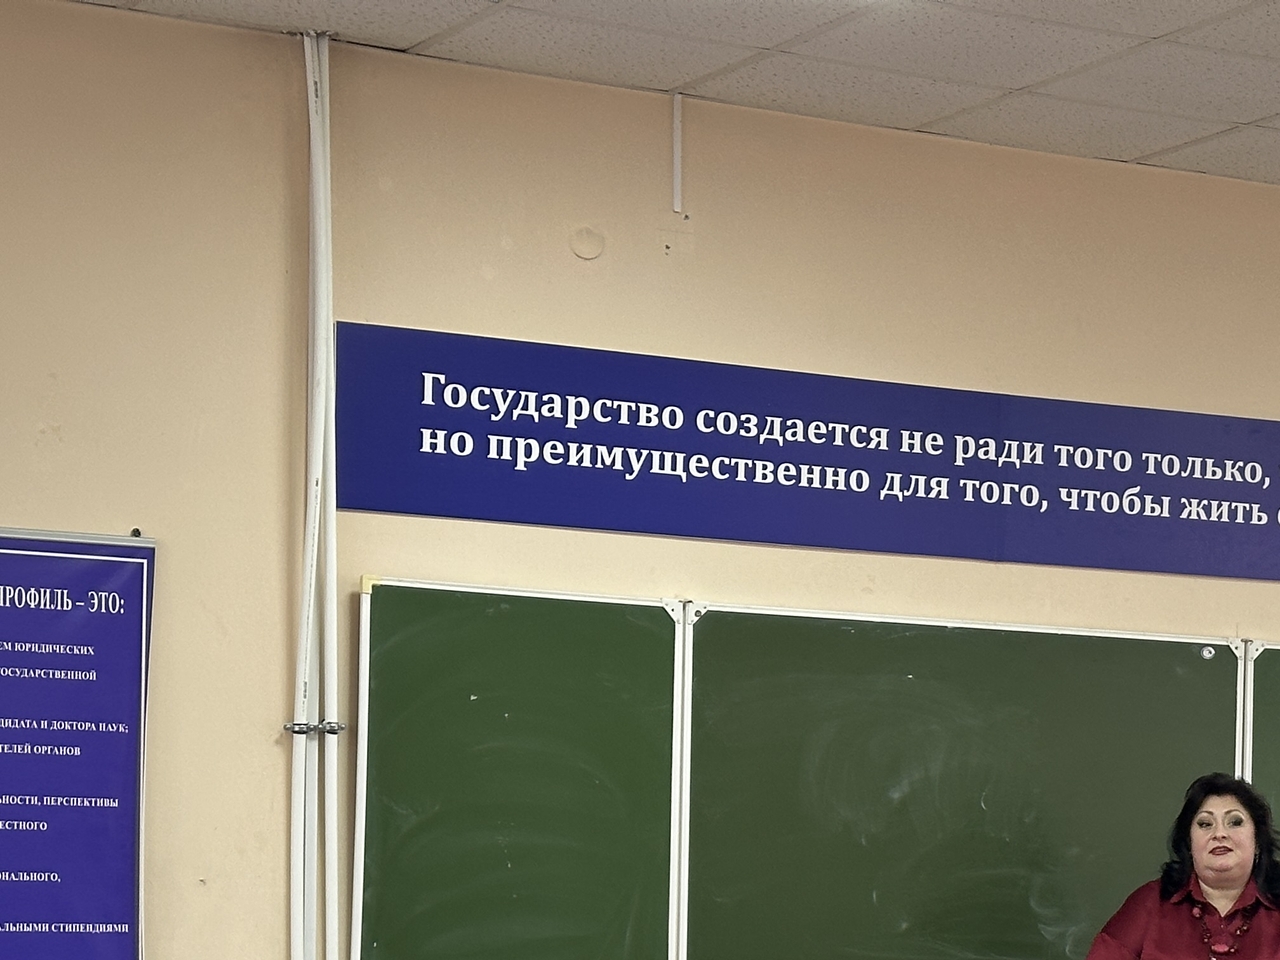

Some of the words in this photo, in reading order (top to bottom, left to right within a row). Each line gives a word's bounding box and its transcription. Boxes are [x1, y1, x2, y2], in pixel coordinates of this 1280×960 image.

[422, 373, 683, 429] Государство
[697, 410, 889, 450] создается
[900, 431, 943, 454] не
[955, 436, 1044, 468] ради
[1054, 445, 1131, 471] того
[1142, 453, 1269, 489] только,
[420, 429, 473, 455] но
[488, 435, 873, 491] преимущественно
[880, 473, 949, 501] для
[960, 480, 1047, 512] того,
[1059, 486, 1170, 517] чтобы
[1180, 498, 1268, 524] жить
[88, 591, 125, 614] ЭТО:
[14, 643, 95, 656] ЮРИДИЧЕСКИХ
[0, 668, 97, 681] ОСУДАРСТВЕННОЙ
[40, 721, 48, 730] И
[49, 721, 97, 731] ДОКТОРА
[33, 746, 81, 756] ОРГАНОВ
[0, 795, 42, 806] НОСТИ,
[43, 797, 119, 808] ПЕРСПЕКТИВЫ
[0, 872, 61, 883] НАЛЬНОГО,
[51, 924, 129, 934] СТИПЕНДИЯМИ
